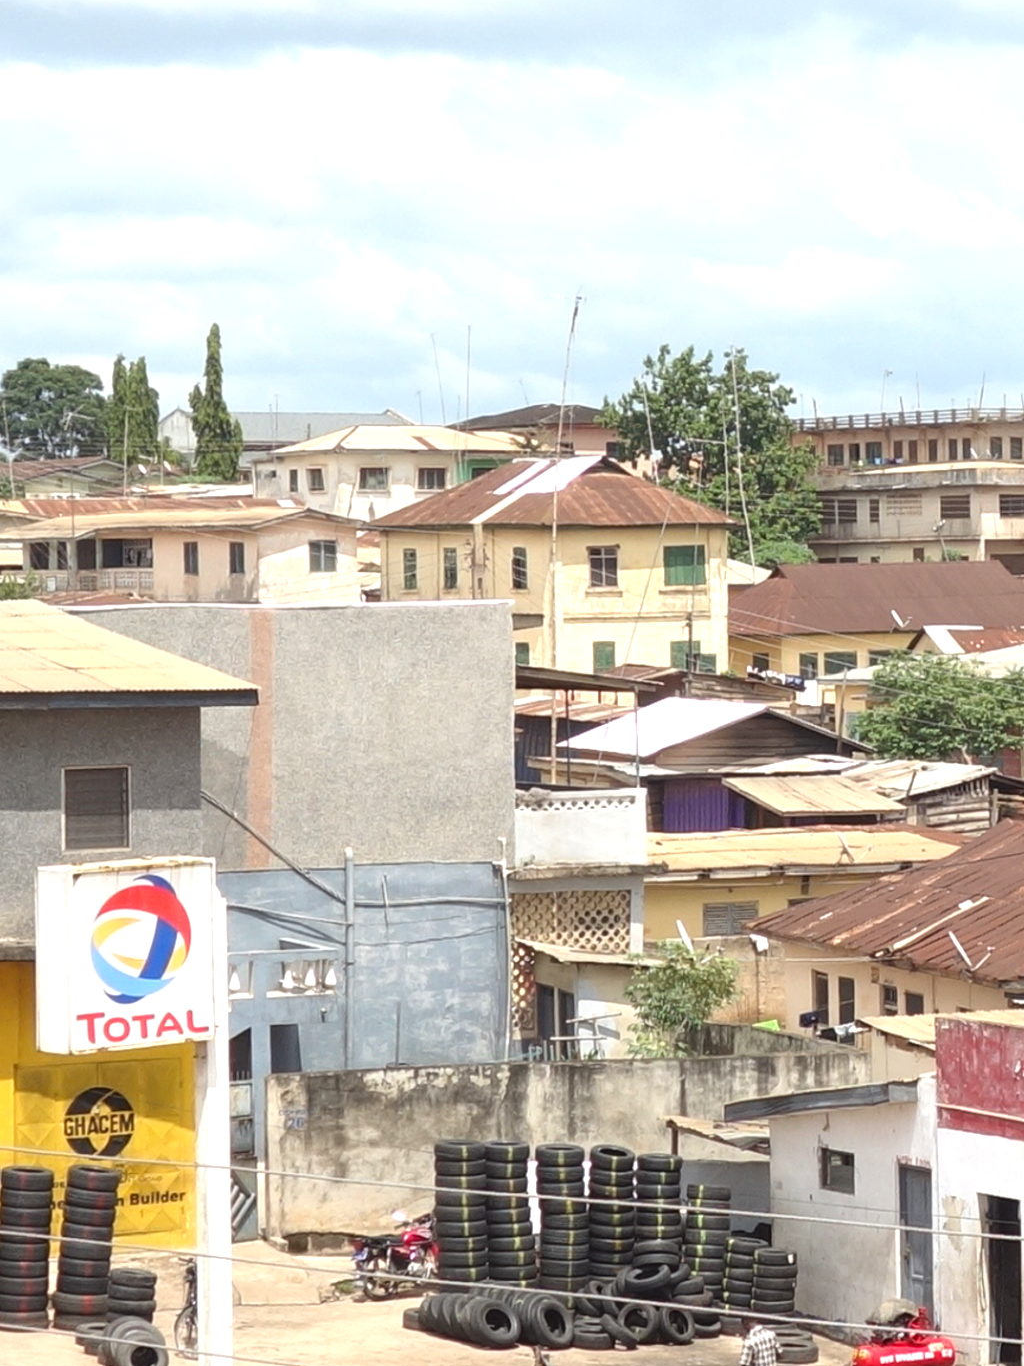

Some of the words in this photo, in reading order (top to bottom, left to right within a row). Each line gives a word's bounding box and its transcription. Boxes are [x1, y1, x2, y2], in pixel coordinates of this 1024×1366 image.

[76, 1009, 209, 1044] TOTAL
[64, 1112, 135, 1137] GHACEM
[129, 1191, 187, 1206] Builder
